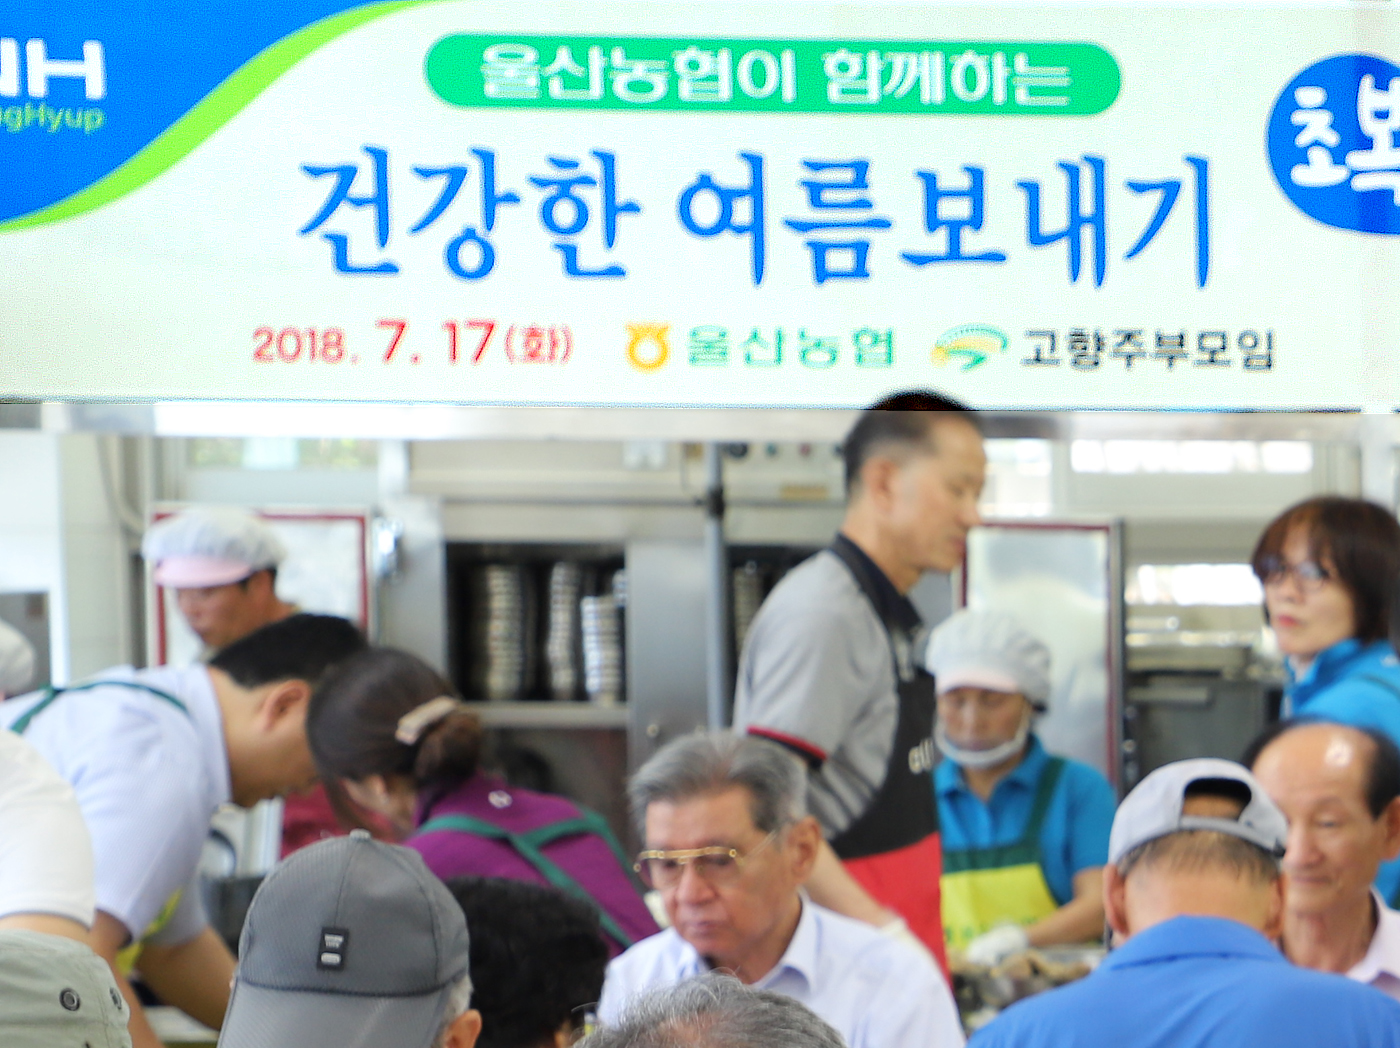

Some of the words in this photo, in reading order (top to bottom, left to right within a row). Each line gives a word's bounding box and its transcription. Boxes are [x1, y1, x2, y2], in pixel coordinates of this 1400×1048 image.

[0, 38, 106, 100] H
[481, 43, 796, 104] 울산농협이
[823, 48, 1074, 106] 함께하는
[298, 146, 642, 281] 건강한
[676, 150, 1211, 289] 여름보내기
[252, 325, 360, 364] 2018.
[442, 319, 573, 365] 17(화)
[686, 323, 898, 370] 울산농협
[1021, 328, 1277, 371] 고향주부모임
